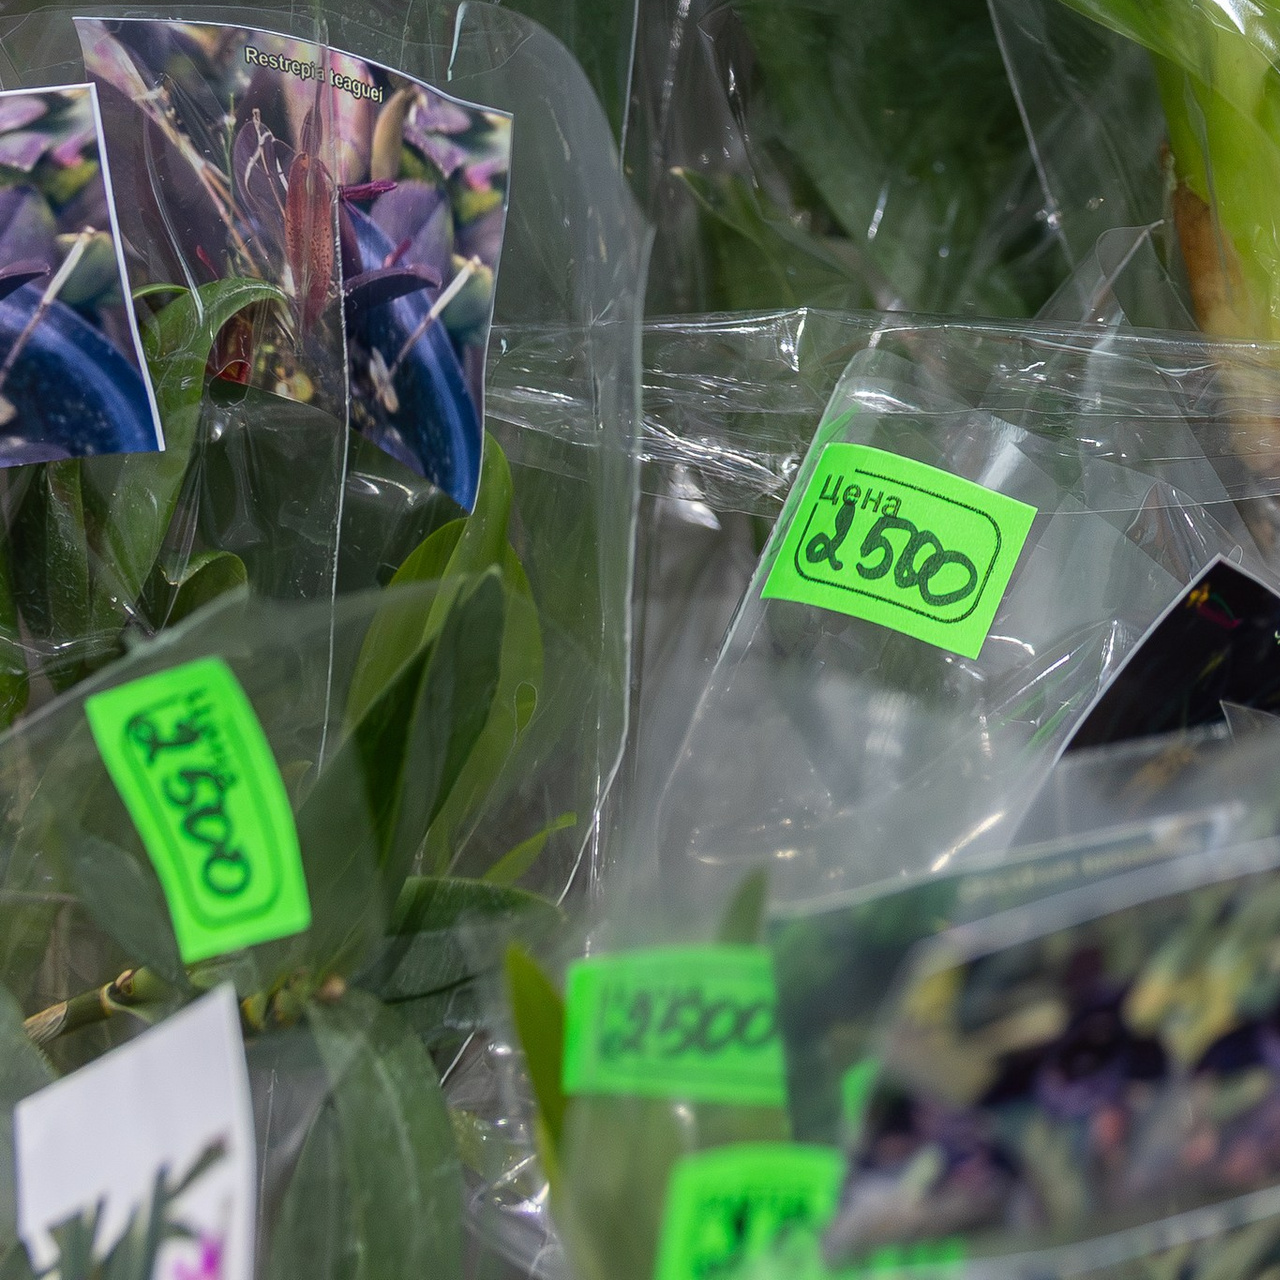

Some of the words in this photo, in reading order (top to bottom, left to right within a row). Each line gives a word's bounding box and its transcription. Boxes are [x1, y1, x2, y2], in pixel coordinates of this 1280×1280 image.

[244, 46, 325, 82] Restrepia
[329, 69, 384, 104] teaguei
[819, 474, 902, 517] Цена
[805, 502, 978, 606] 2500
